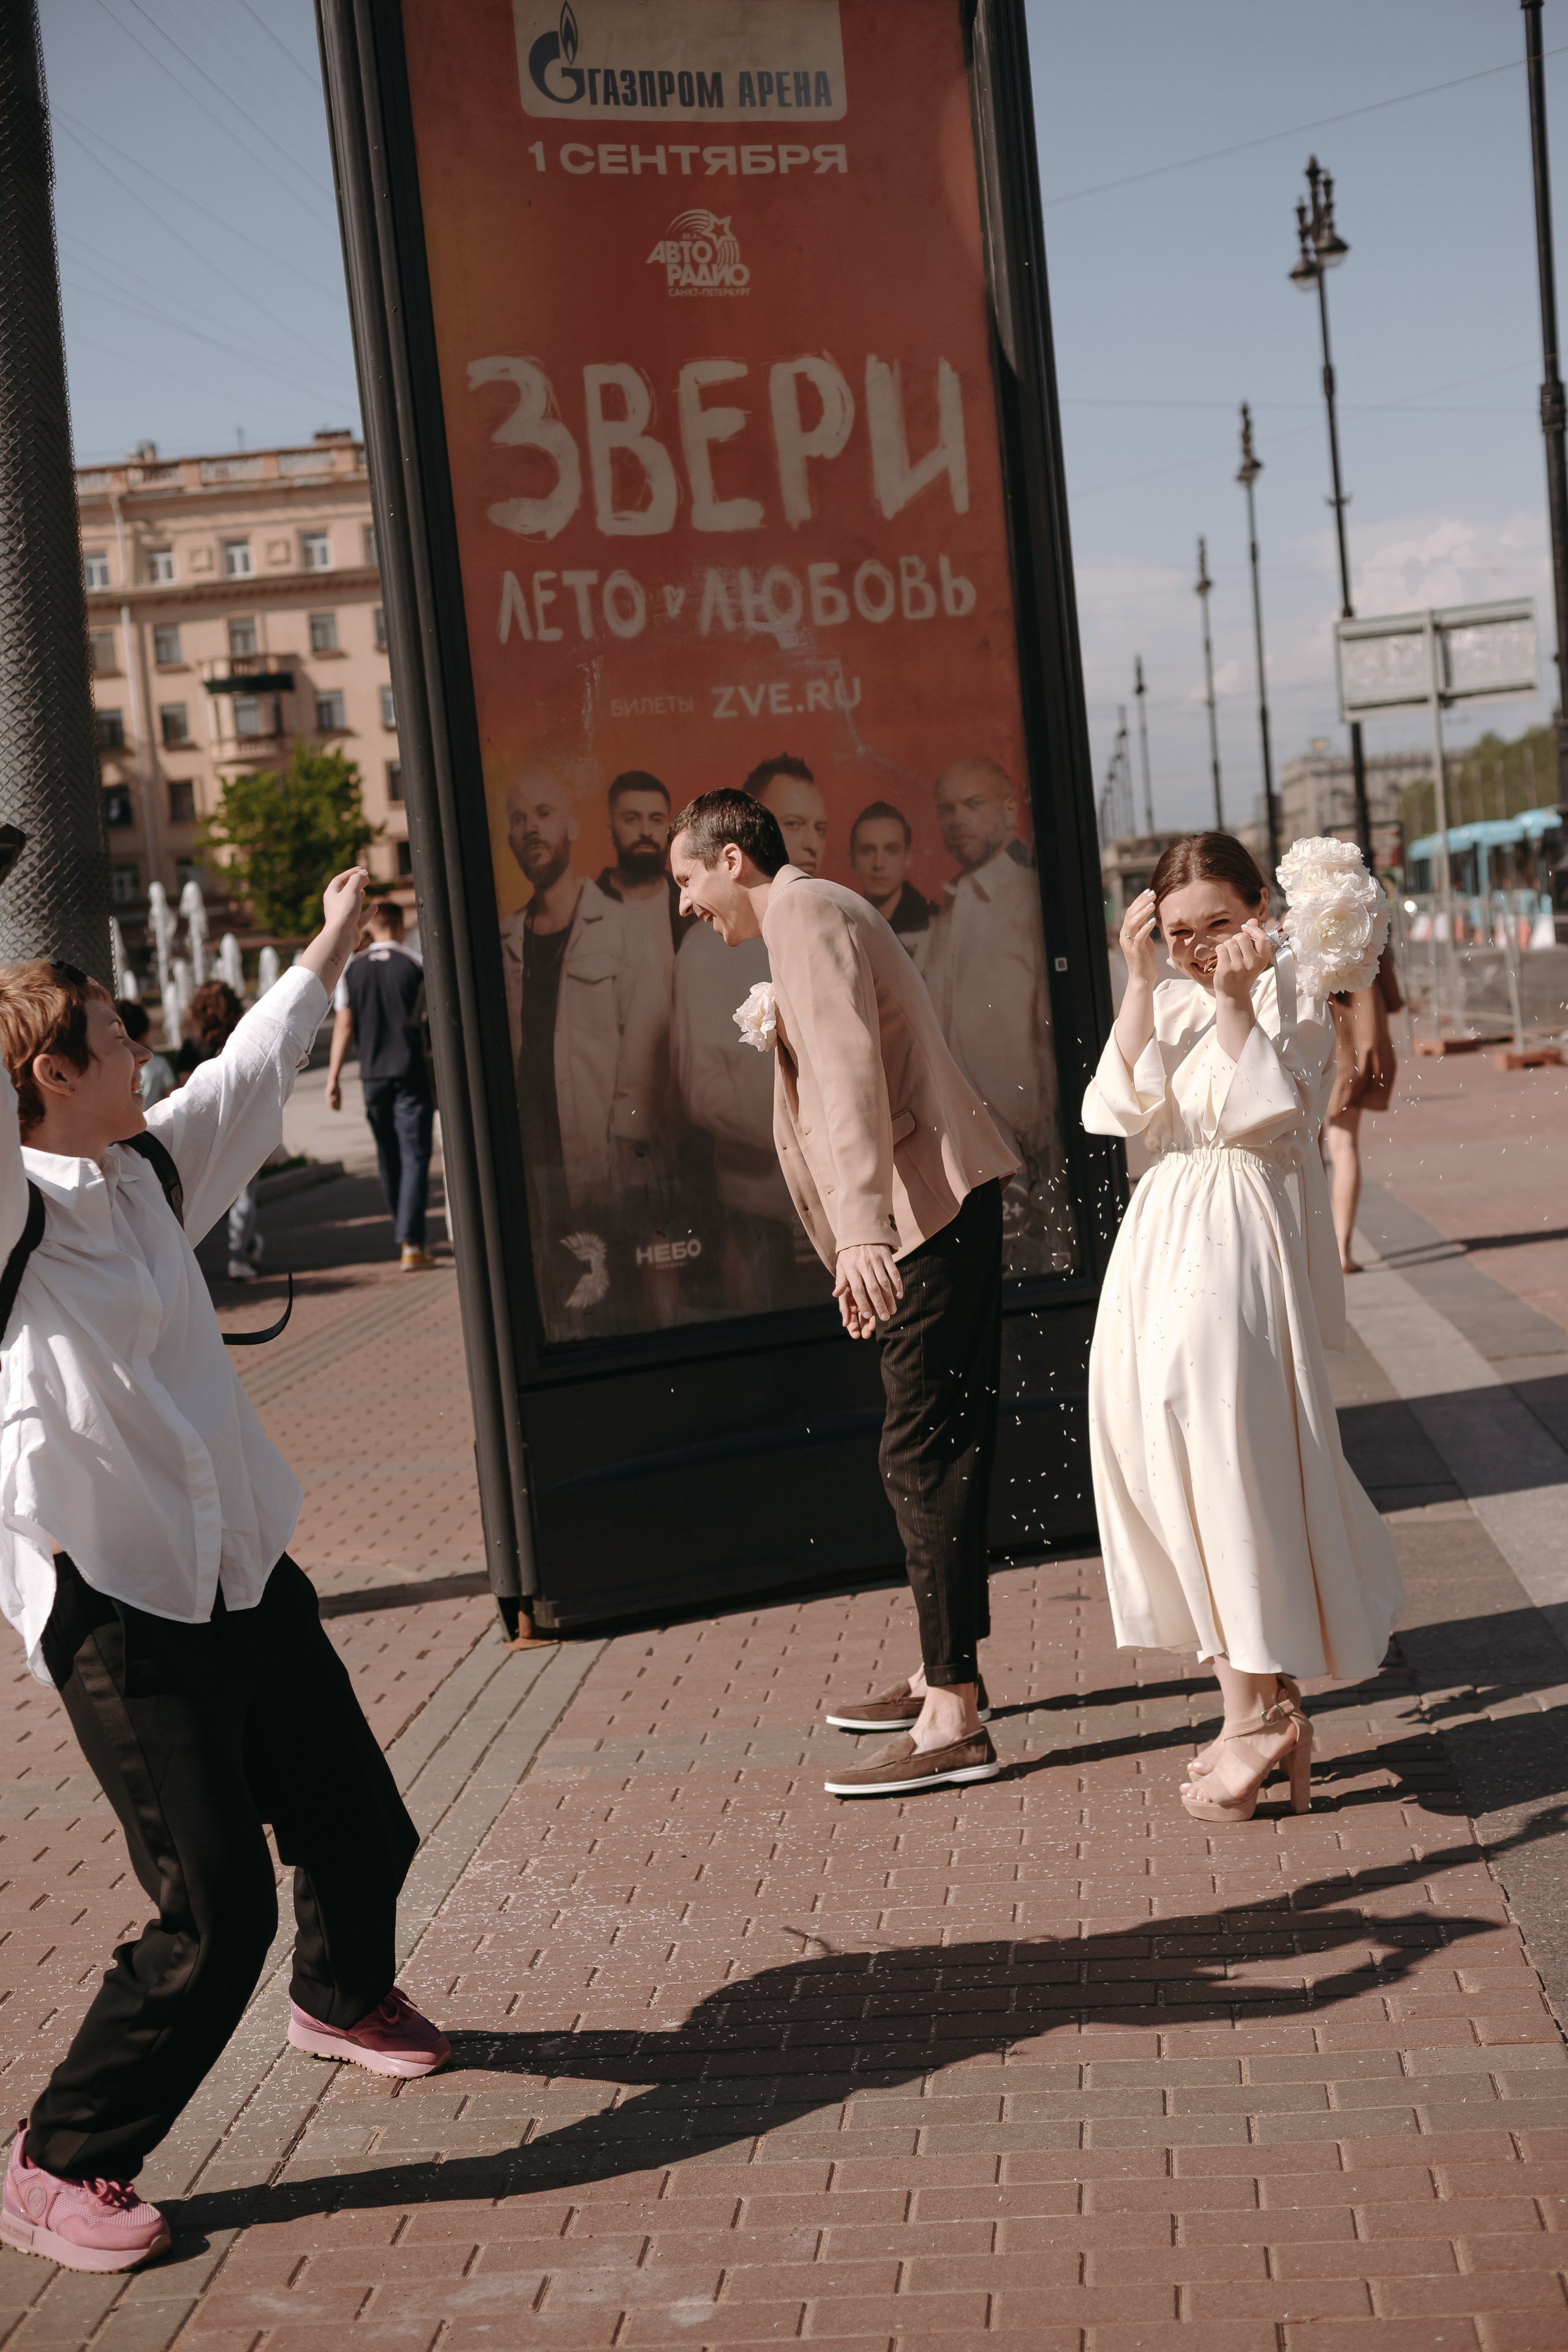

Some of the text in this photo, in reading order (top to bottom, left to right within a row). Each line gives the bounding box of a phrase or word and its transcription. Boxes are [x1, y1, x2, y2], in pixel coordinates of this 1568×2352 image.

[587, 68, 724, 108] ГАЗПРОМ
[738, 70, 833, 108] АРЕНА
[528, 141, 848, 176] 1 СЕНТЯБРЯ
[646, 240, 713, 264] АВТО
[667, 263, 750, 287] РАДИО
[466, 351, 970, 541] ЗВЕРИ
[497, 554, 977, 644] ЛЕТО ЛЮБОВЬ
[611, 695, 694, 717] БИЛЕТЫ
[712, 677, 862, 719] ZVE.RU
[1003, 1200, 1023, 1221] 2+
[635, 1238, 703, 1266] НЕБО
